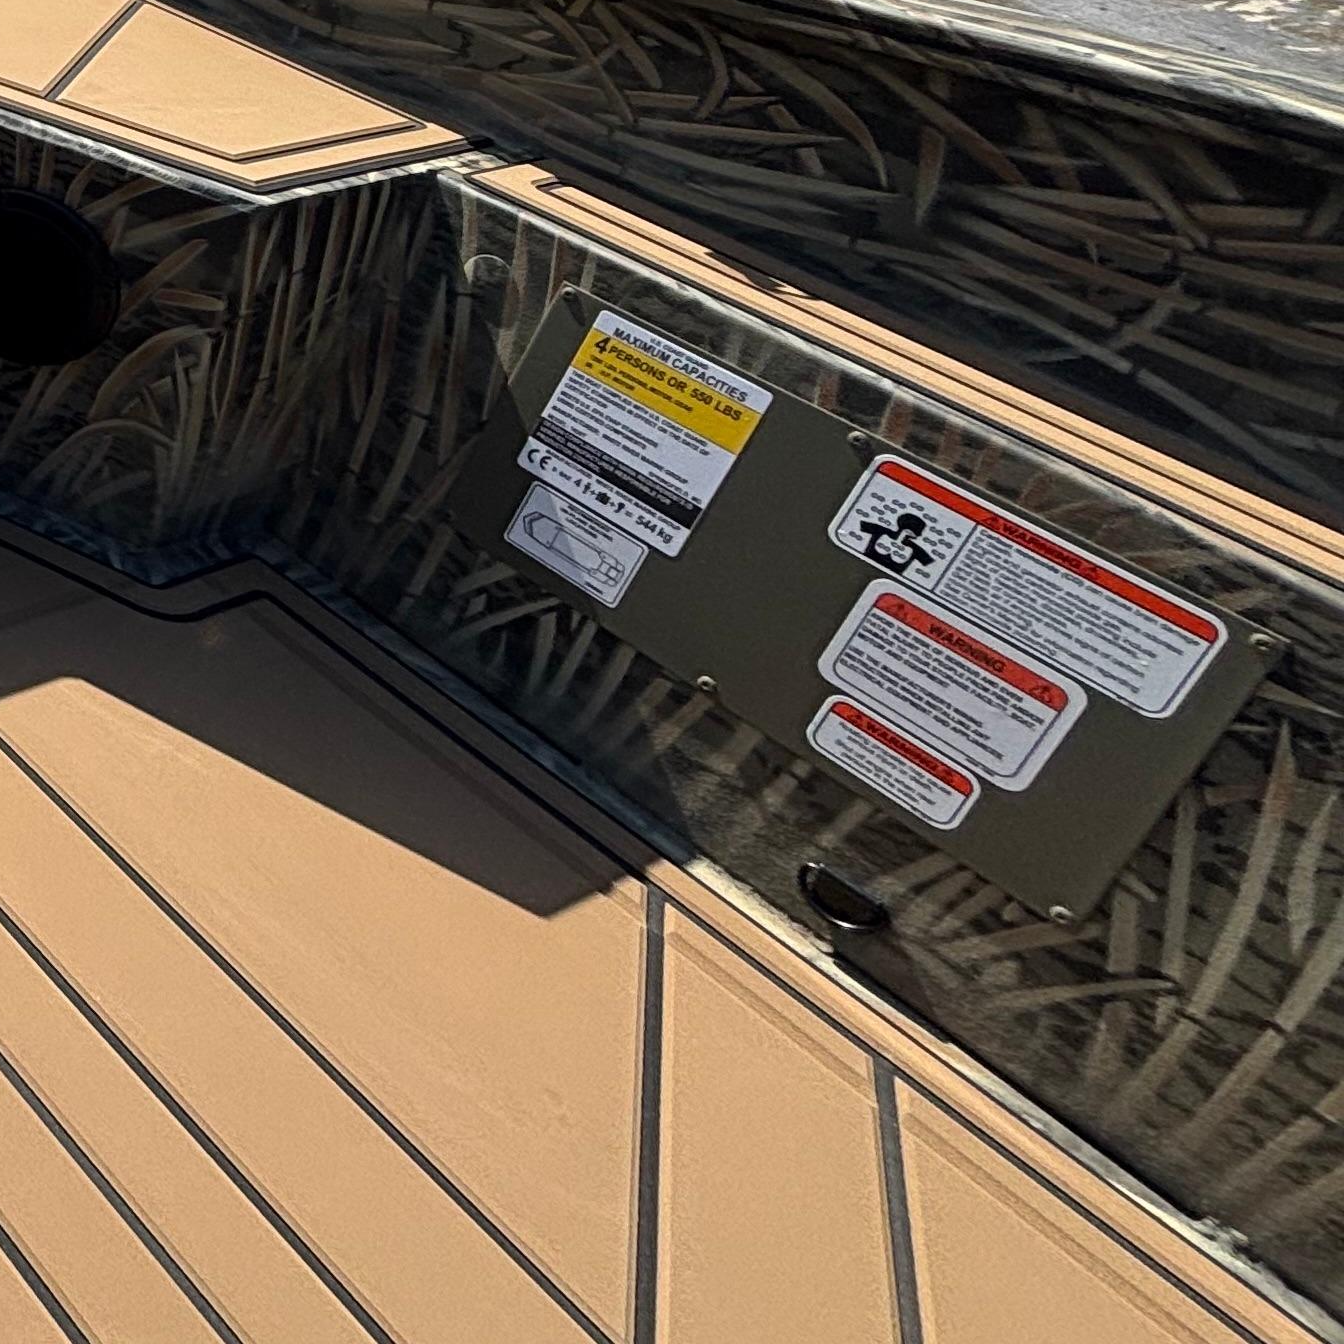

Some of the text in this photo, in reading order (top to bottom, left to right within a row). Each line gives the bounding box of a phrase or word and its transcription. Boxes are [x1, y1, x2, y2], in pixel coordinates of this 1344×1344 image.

[594, 337, 610, 353] 4
[608, 346, 665, 380] PERSONS
[666, 376, 687, 392] OR
[690, 388, 712, 404] 550
[714, 400, 742, 420] LBS
[613, 328, 670, 362] MAXIMUM
[672, 358, 747, 401] CAPACITIES
[635, 515, 657, 532] 544
[656, 527, 673, 543] kg
[929, 624, 1005, 672] WARNING
